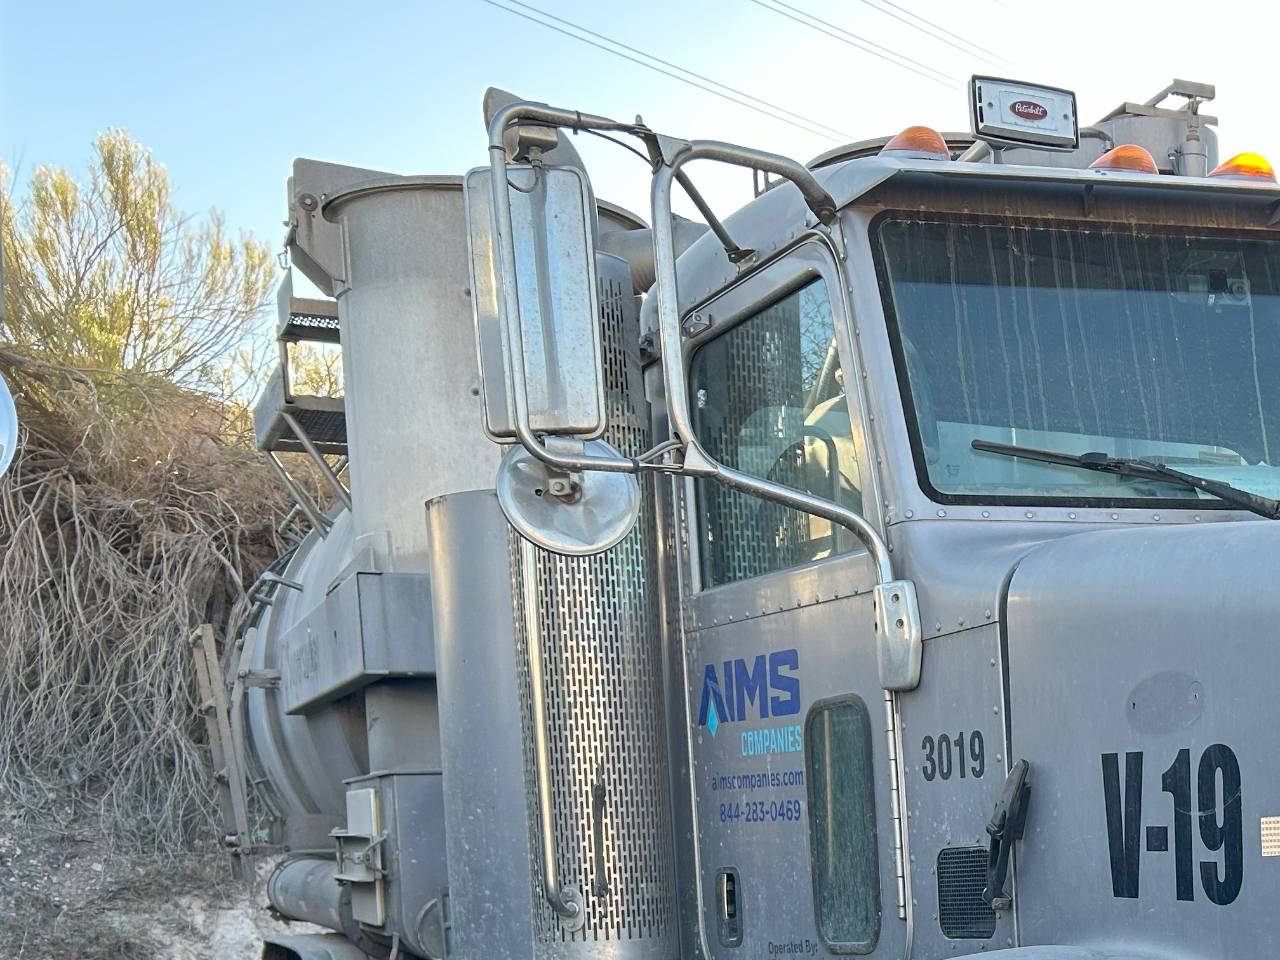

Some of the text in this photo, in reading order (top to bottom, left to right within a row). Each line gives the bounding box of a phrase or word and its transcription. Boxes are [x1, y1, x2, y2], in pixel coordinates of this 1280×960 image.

[698, 649, 800, 727] AIMS
[741, 726, 802, 756] COMPANIES
[921, 730, 985, 781] 3019
[711, 769, 804, 792] aimscompanies.com
[719, 800, 801, 823] 844-283-0469
[1101, 743, 1244, 905] V-19
[768, 939, 818, 957] Operated By:
